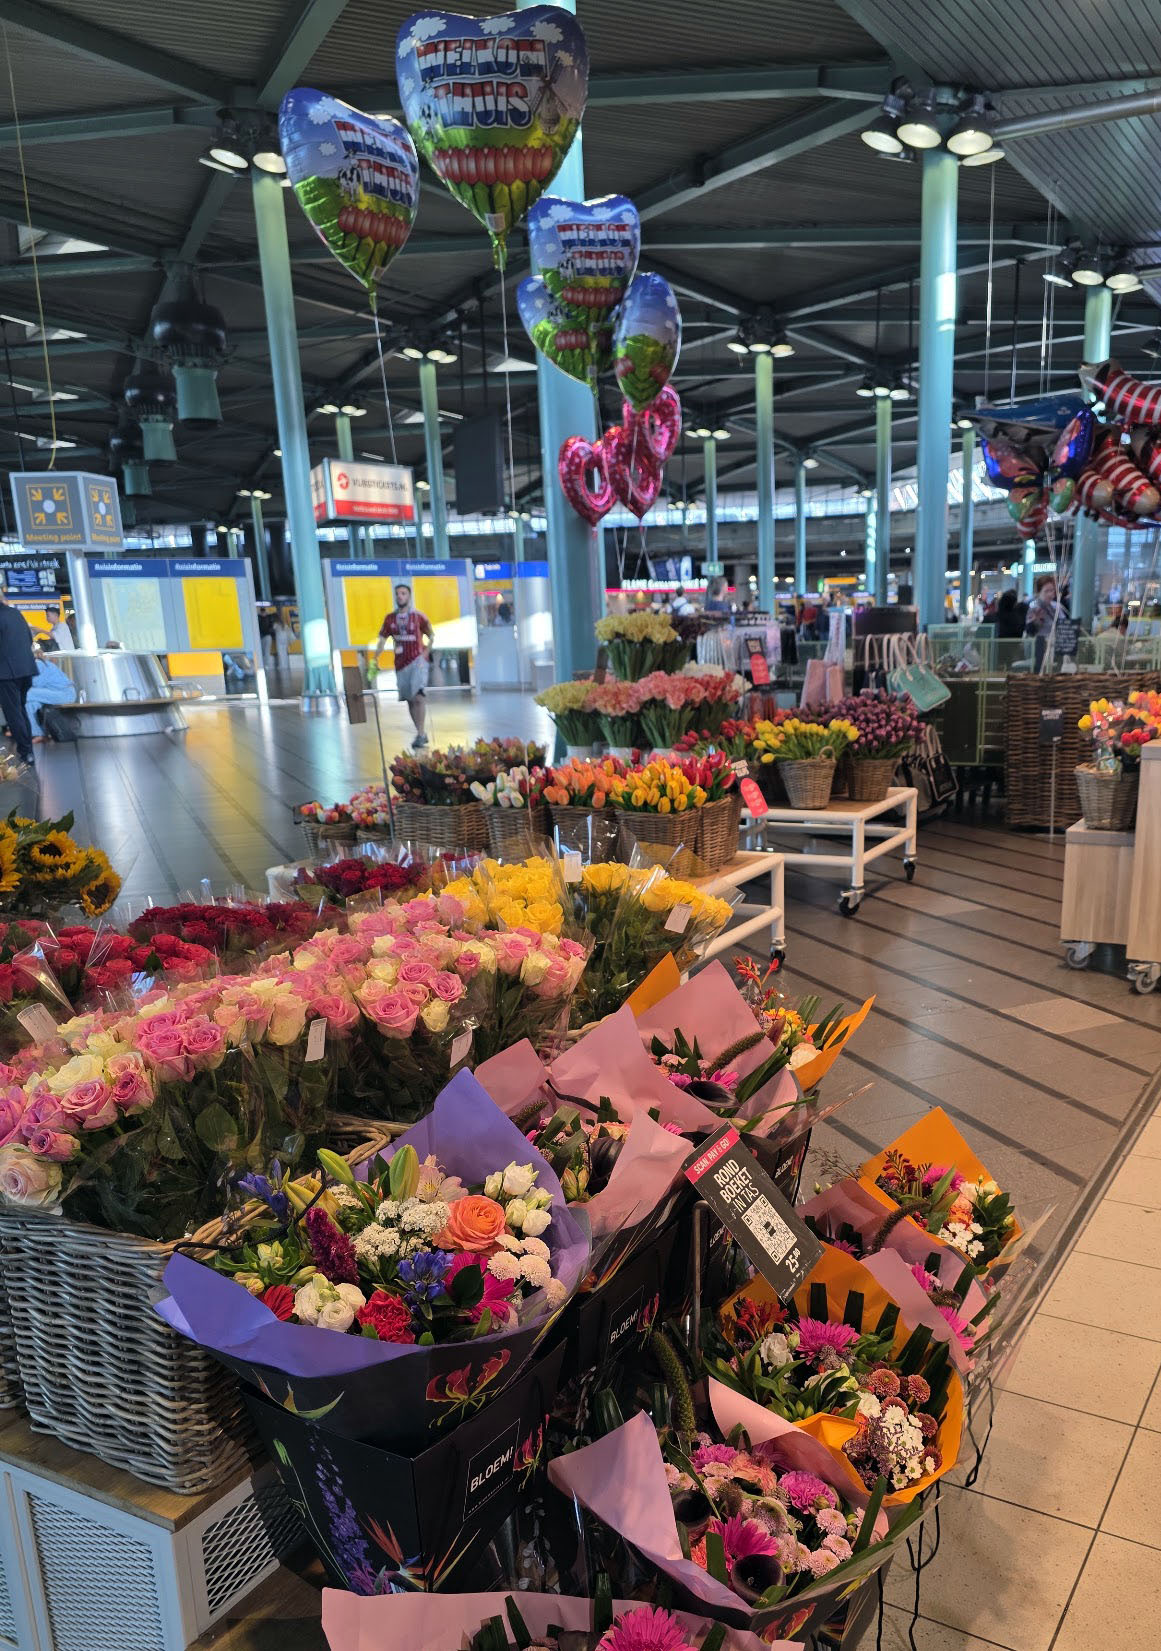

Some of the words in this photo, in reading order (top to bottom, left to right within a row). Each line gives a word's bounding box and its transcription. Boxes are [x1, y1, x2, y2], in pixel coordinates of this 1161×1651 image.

[415, 37, 548, 81] WELKOM
[433, 81, 533, 128] THUIS
[557, 223, 632, 253] WELKOM
[572, 250, 624, 276] THUIS
[26, 533, 59, 543] Meeting
[61, 533, 82, 543] point
[707, 1147, 720, 1161] PAY
[713, 1159, 740, 1188] ROND
[719, 1166, 753, 1204] BOEKET
[732, 1196, 747, 1213] IN
[740, 1182, 759, 1203] TAS
[609, 1308, 639, 1345] BLOEM!
[470, 1445, 514, 1493] BLOEM!
